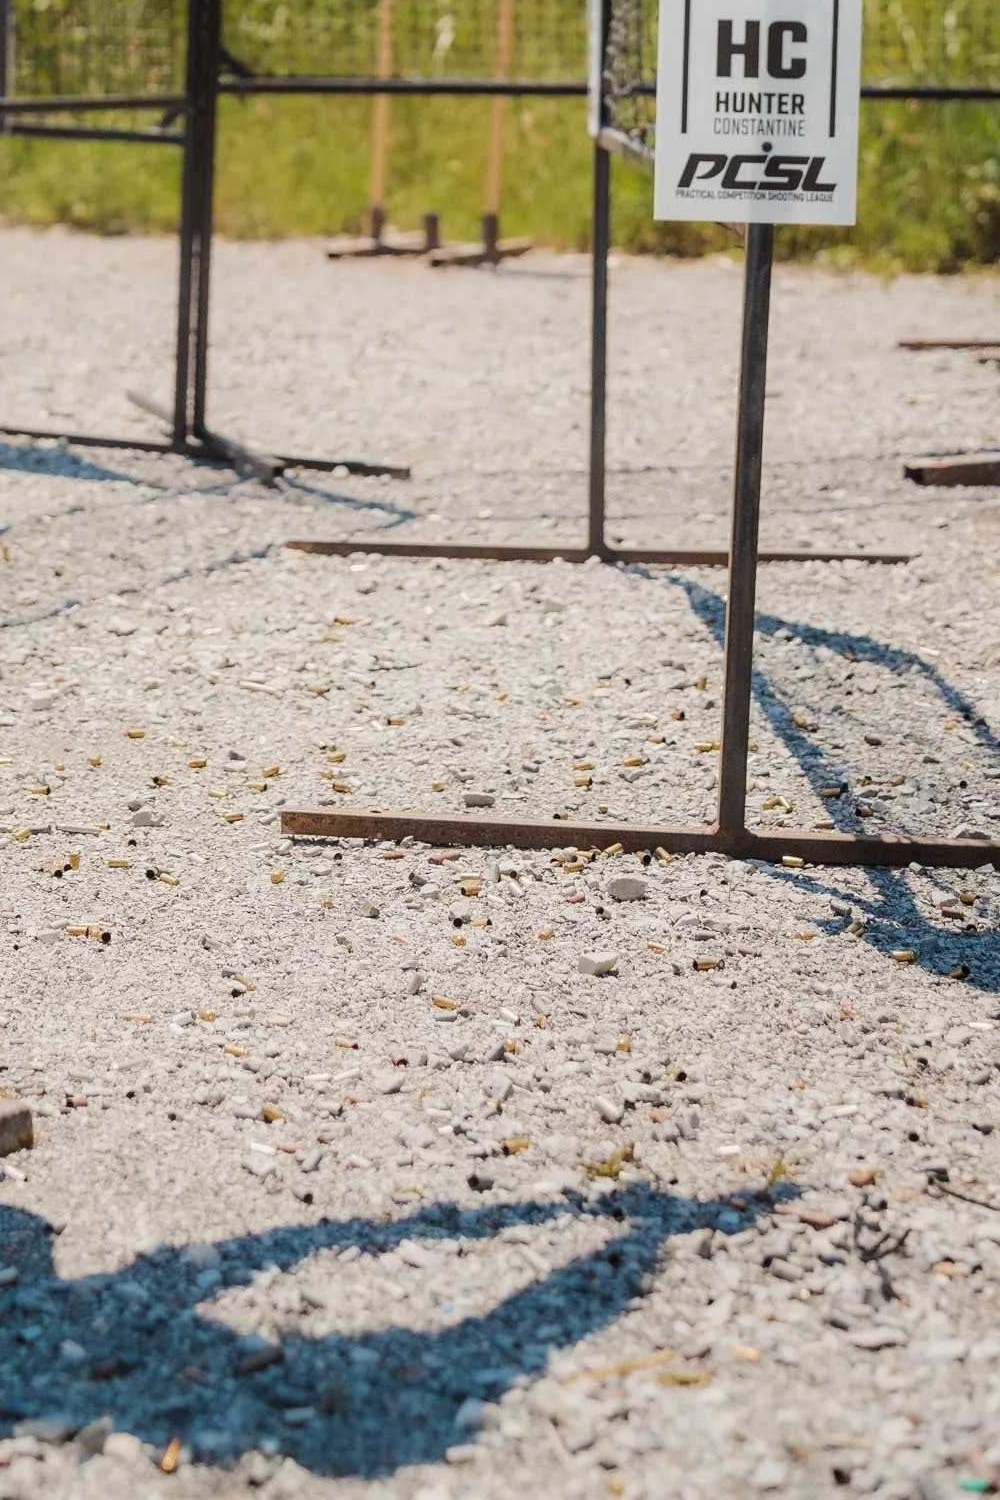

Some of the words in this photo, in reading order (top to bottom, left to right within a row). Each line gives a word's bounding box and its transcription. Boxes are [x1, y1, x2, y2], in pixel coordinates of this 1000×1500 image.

[716, 19, 808, 79] HC
[715, 91, 805, 115] HUNTER
[713, 117, 806, 137] CONSTANTINE
[677, 153, 838, 193] PCSL
[675, 189, 716, 200] PRACTICAL
